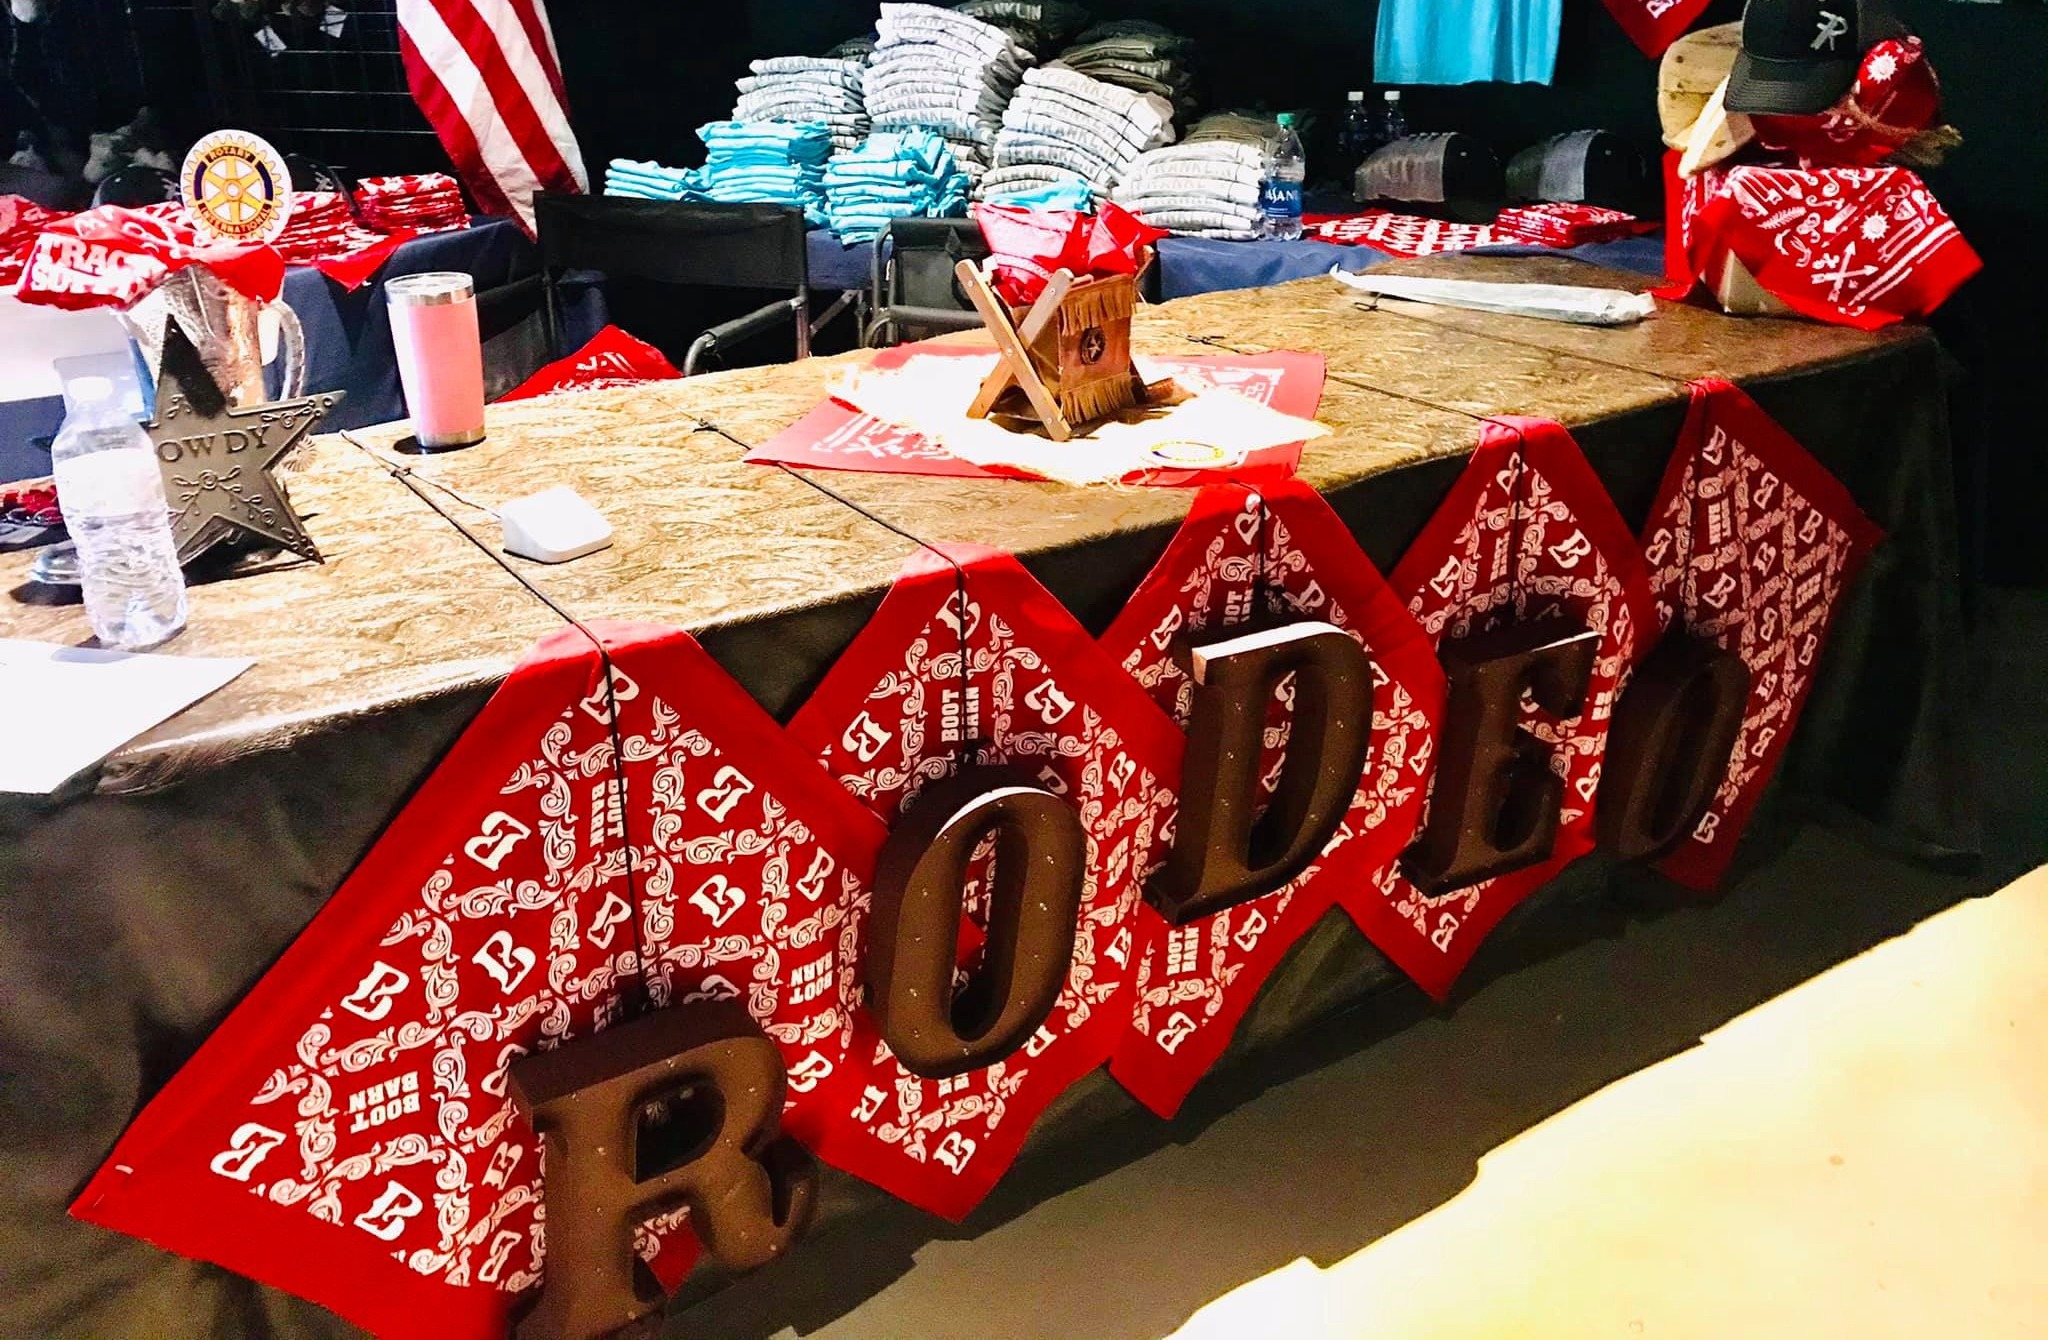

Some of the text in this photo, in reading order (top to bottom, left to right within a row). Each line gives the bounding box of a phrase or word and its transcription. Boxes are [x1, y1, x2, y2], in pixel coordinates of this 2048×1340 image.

[210, 147, 251, 160] ROTARY
[200, 204, 272, 235] INTERNATIONAL
[157, 423, 272, 463] OWDY
[1223, 590, 1243, 627] OOT
[941, 689, 959, 742] BOOT
[962, 687, 979, 740] BARN
[590, 781, 605, 847] BARN
[790, 951, 833, 987] BARN
[1166, 930, 1183, 976] BOOT
[1181, 927, 1199, 972] BARN
[788, 970, 833, 1005] BOOT
[348, 1071, 419, 1114] BARN
[350, 1092, 420, 1134] BOOT
